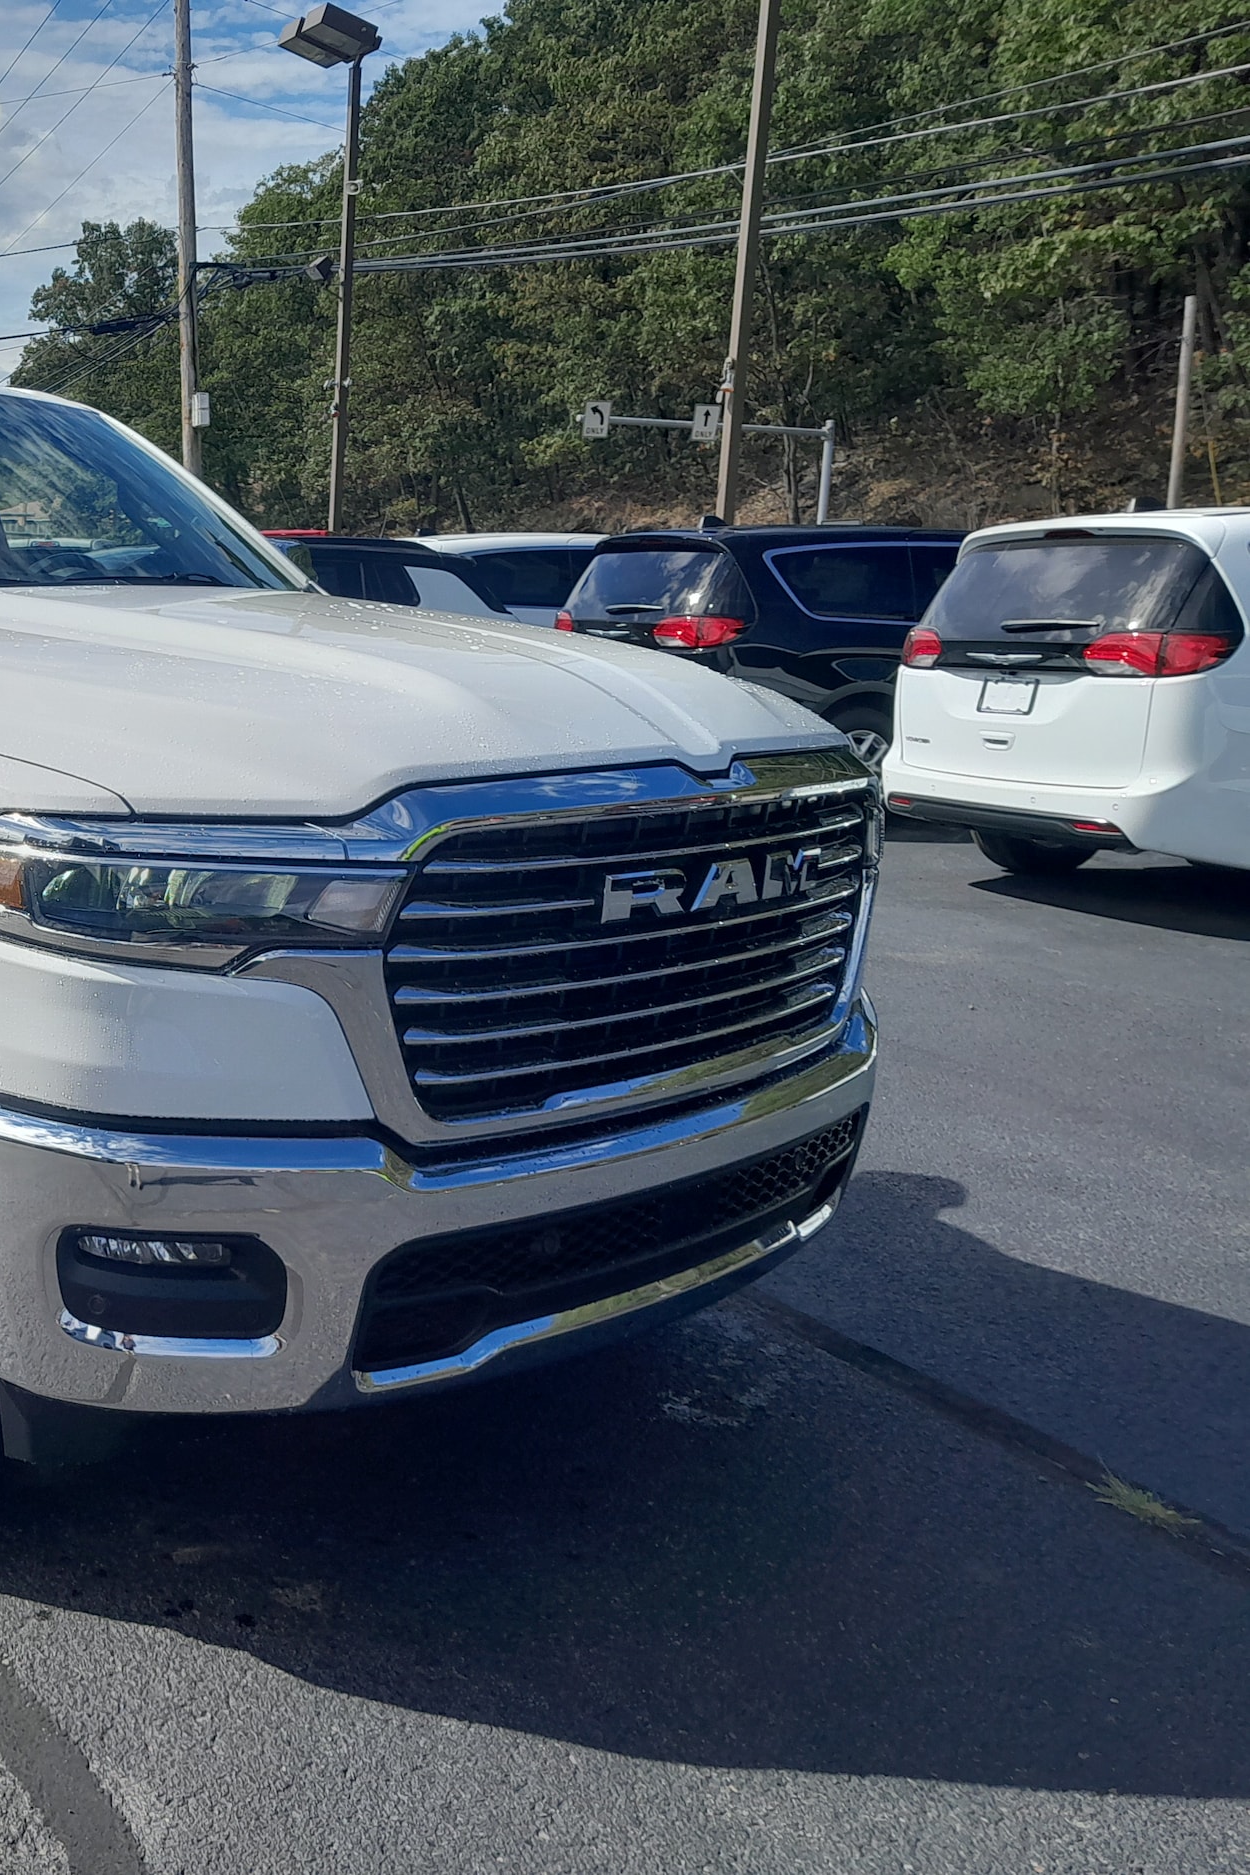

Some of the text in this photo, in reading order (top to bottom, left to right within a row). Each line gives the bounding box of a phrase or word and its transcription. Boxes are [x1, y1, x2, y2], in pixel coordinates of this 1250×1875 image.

[585, 426, 605, 435] ONLY
[694, 430, 713, 439] ONLY
[601, 847, 822, 924] RAM
